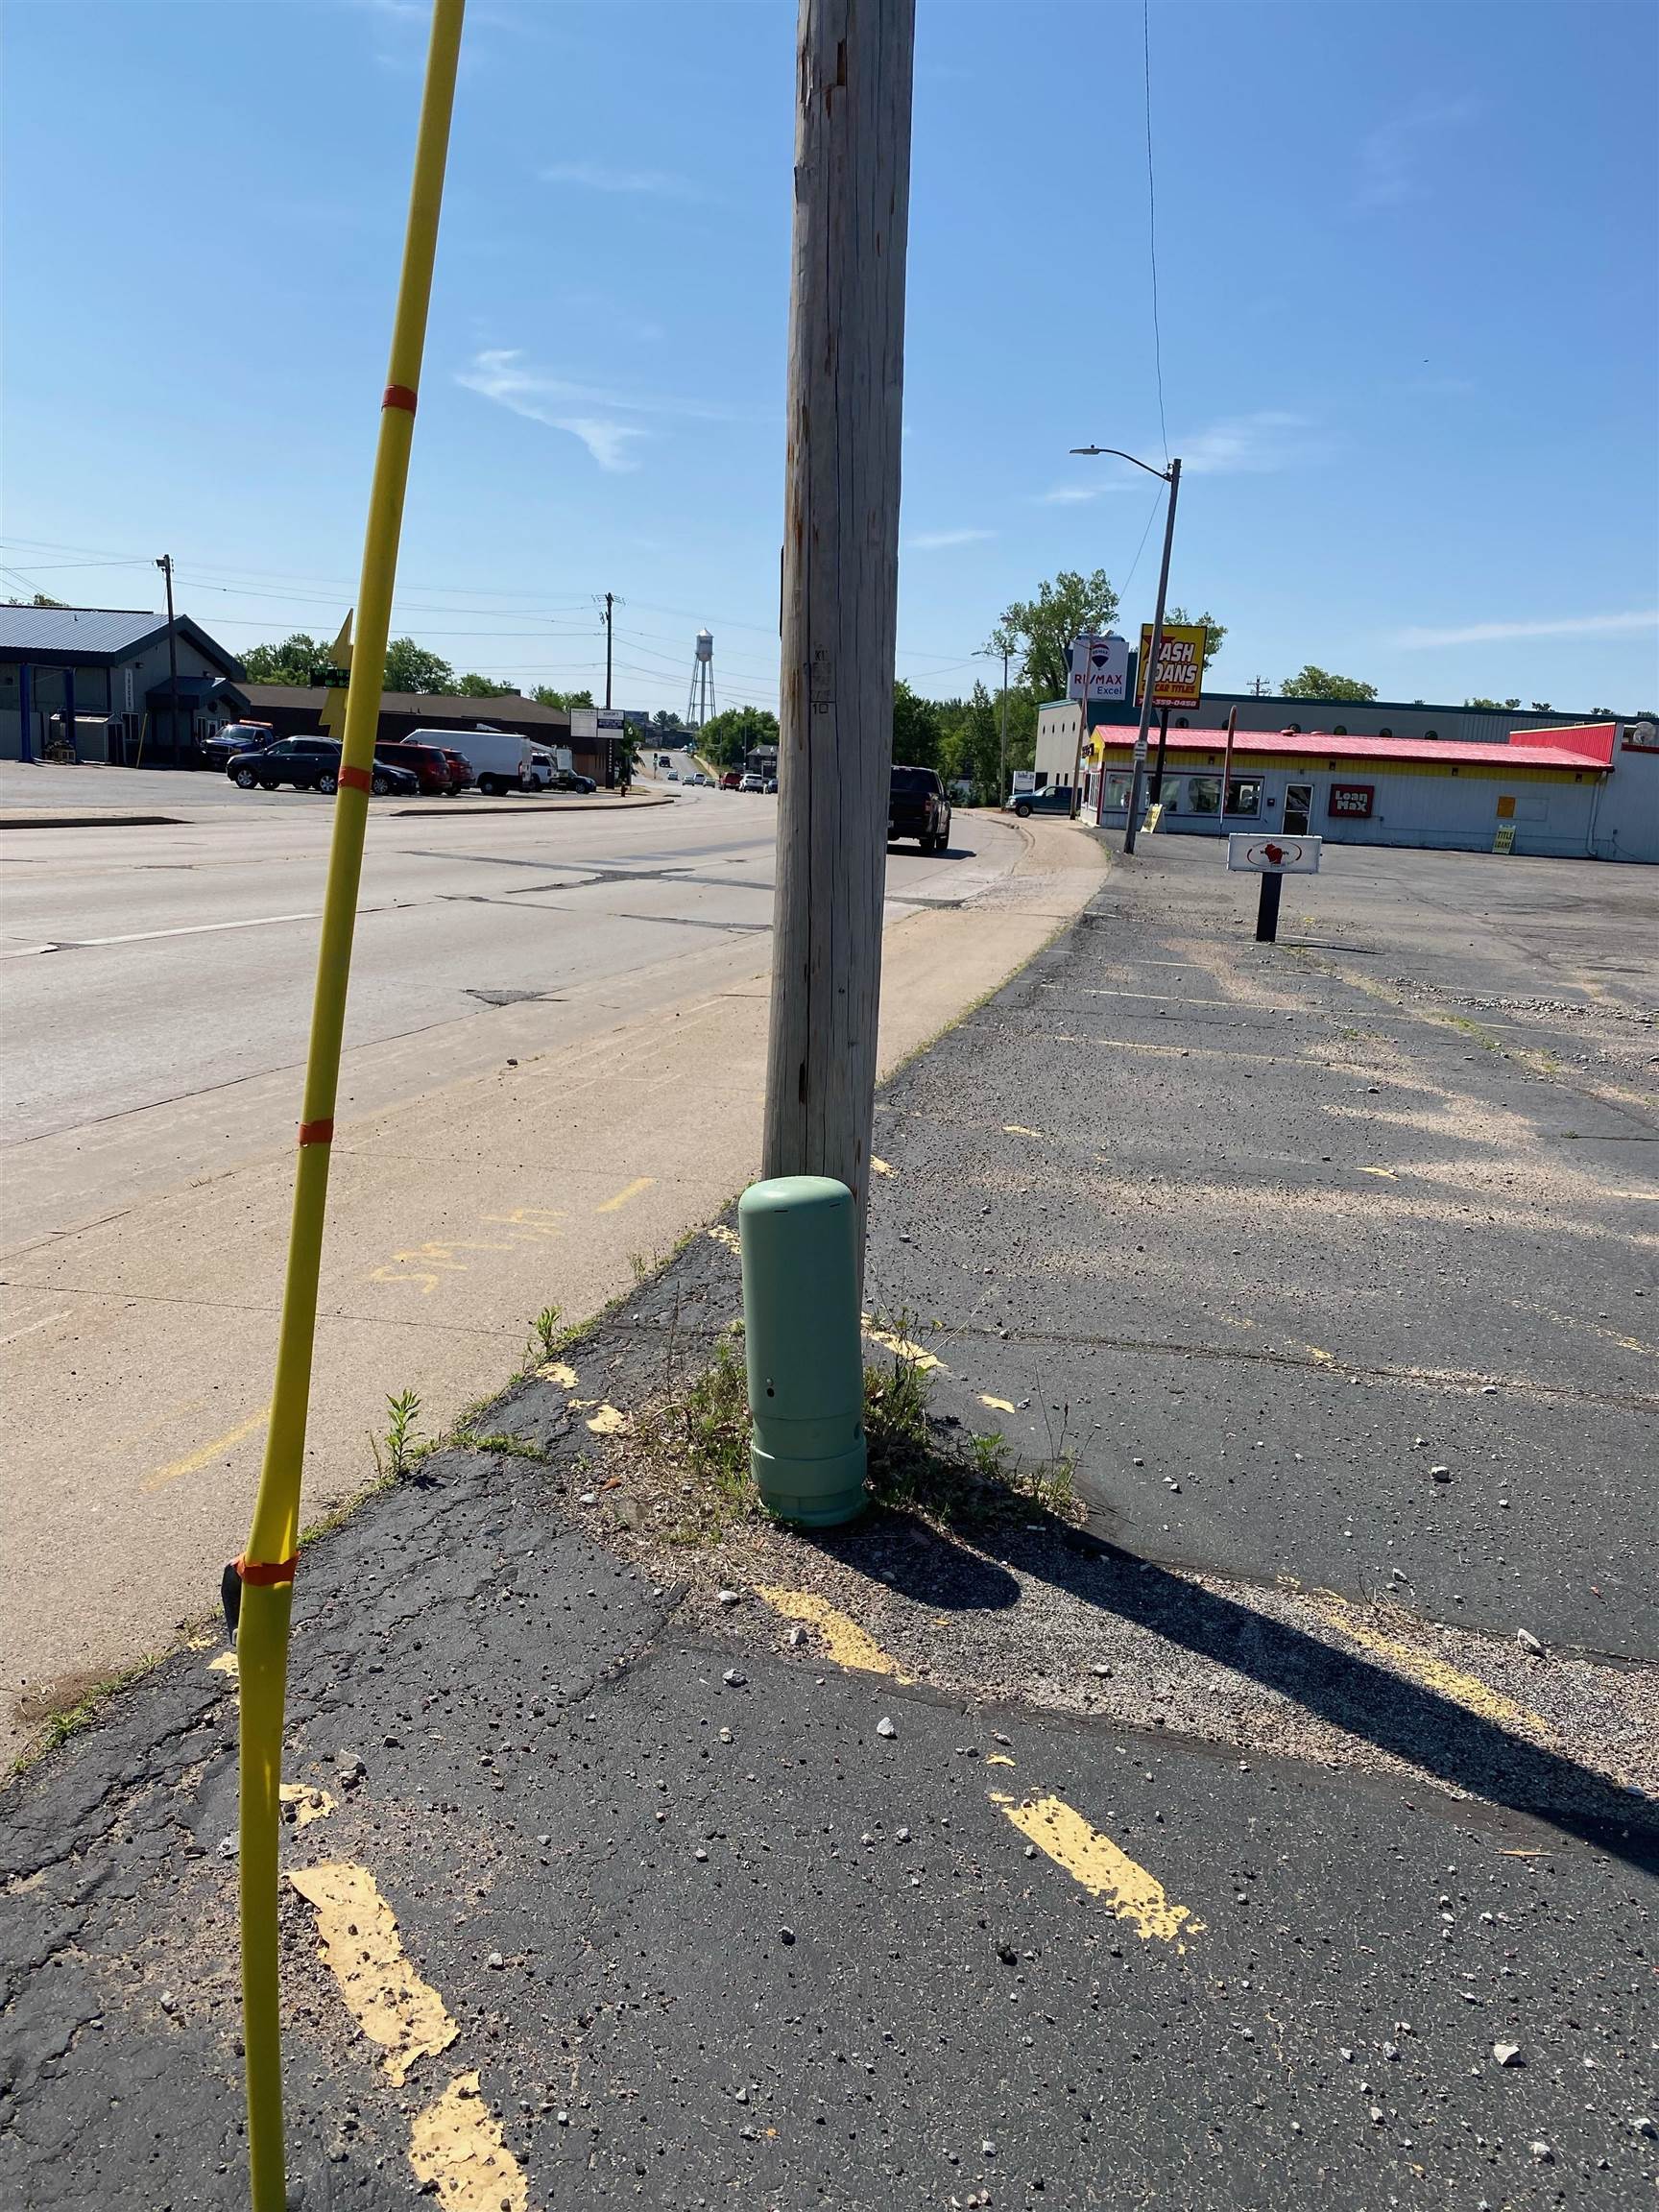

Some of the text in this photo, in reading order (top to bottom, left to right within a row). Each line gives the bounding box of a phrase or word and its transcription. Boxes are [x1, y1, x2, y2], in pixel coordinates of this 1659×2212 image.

[1159, 642, 1194, 662] ASH
[1097, 685, 1121, 695] Excel
[1171, 685, 1195, 693] TITLES
[1139, 698, 1197, 707] 7-359-0450
[1335, 790, 1367, 803] Loan
[1497, 830, 1513, 839] TITLE
